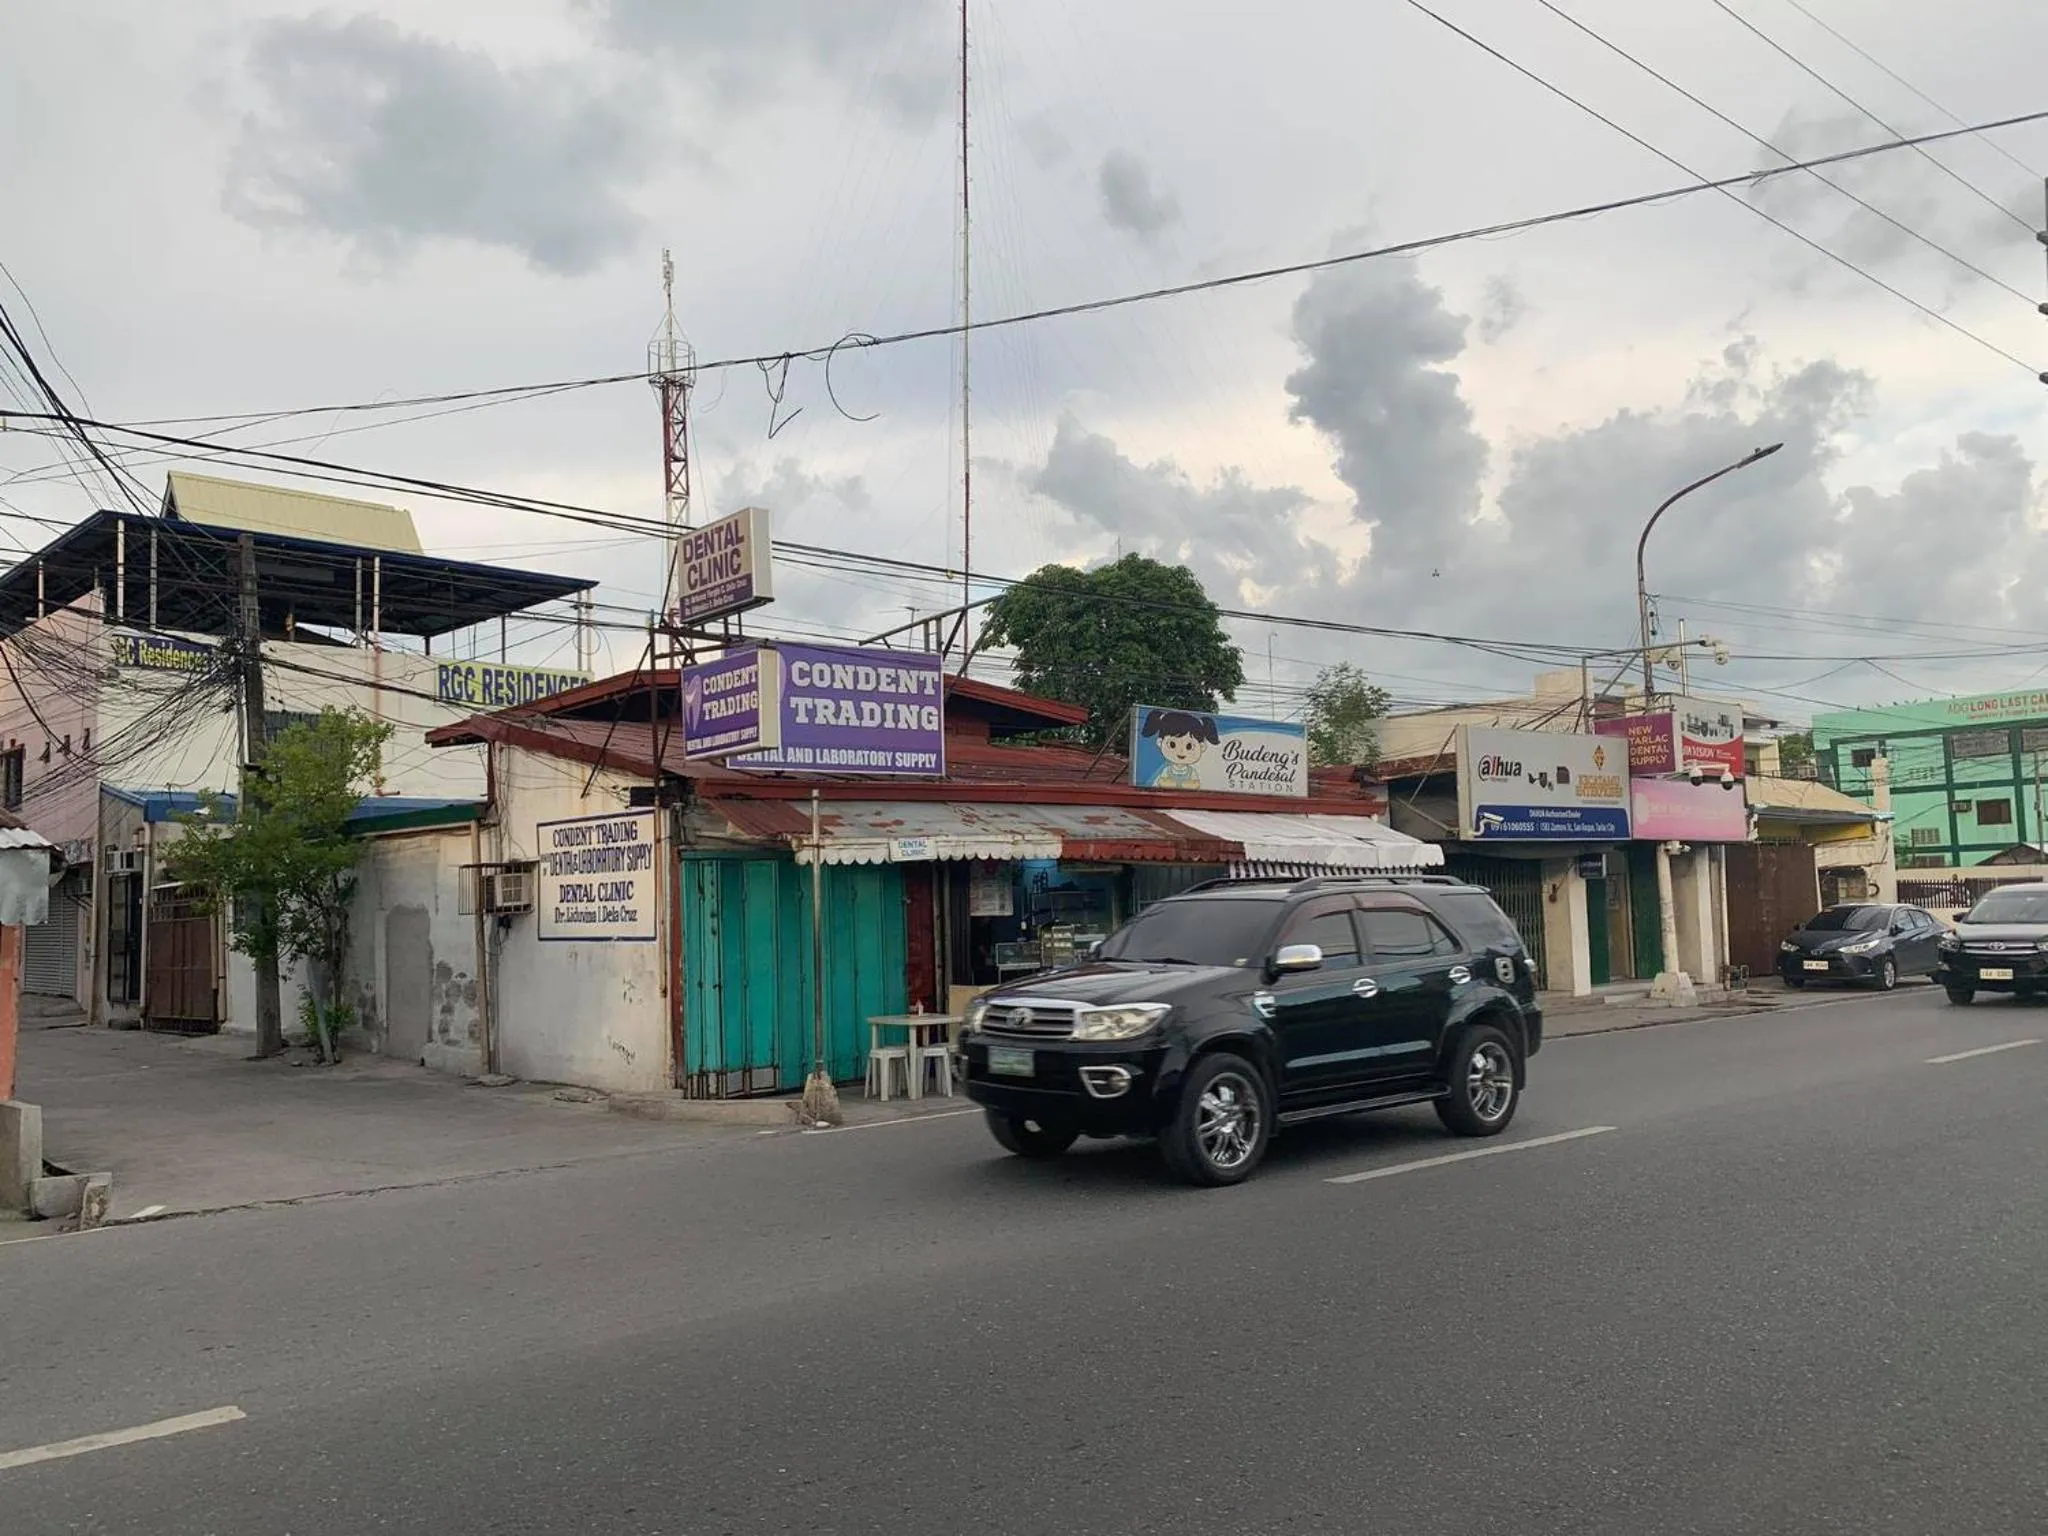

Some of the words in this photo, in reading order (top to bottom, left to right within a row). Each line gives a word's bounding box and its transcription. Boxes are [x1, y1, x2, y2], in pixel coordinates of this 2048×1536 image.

[683, 519, 745, 564] DENTAL
[687, 547, 741, 590] CLINIC
[138, 639, 209, 672] Residences
[438, 664, 476, 701] RGC
[482, 668, 589, 705] RESIDENC
[702, 664, 758, 695] CONDENT
[791, 661, 939, 695] CONDENT
[703, 690, 759, 720] TRADING
[790, 696, 938, 731] TRADING
[1970, 698, 1998, 712] LONG
[2000, 695, 2027, 709] LAST
[1628, 725, 1653, 736] NEW
[1629, 734, 1669, 745] TARLAC
[787, 747, 813, 763] AND
[816, 747, 892, 766] LABORATORY
[895, 750, 937, 769] SUPPLY
[1222, 739, 1300, 772] Budeng's
[1630, 744, 1670, 756] DENTAL
[1630, 754, 1668, 767] SUPPLY
[1225, 761, 1297, 783] Pandesal
[1229, 780, 1294, 792] STATION
[553, 825, 594, 848] CONDENT
[594, 821, 638, 846] TRADING
[626, 843, 652, 872] SUPPLY
[559, 883, 596, 904] DENTAL
[598, 881, 634, 902] CLINIC
